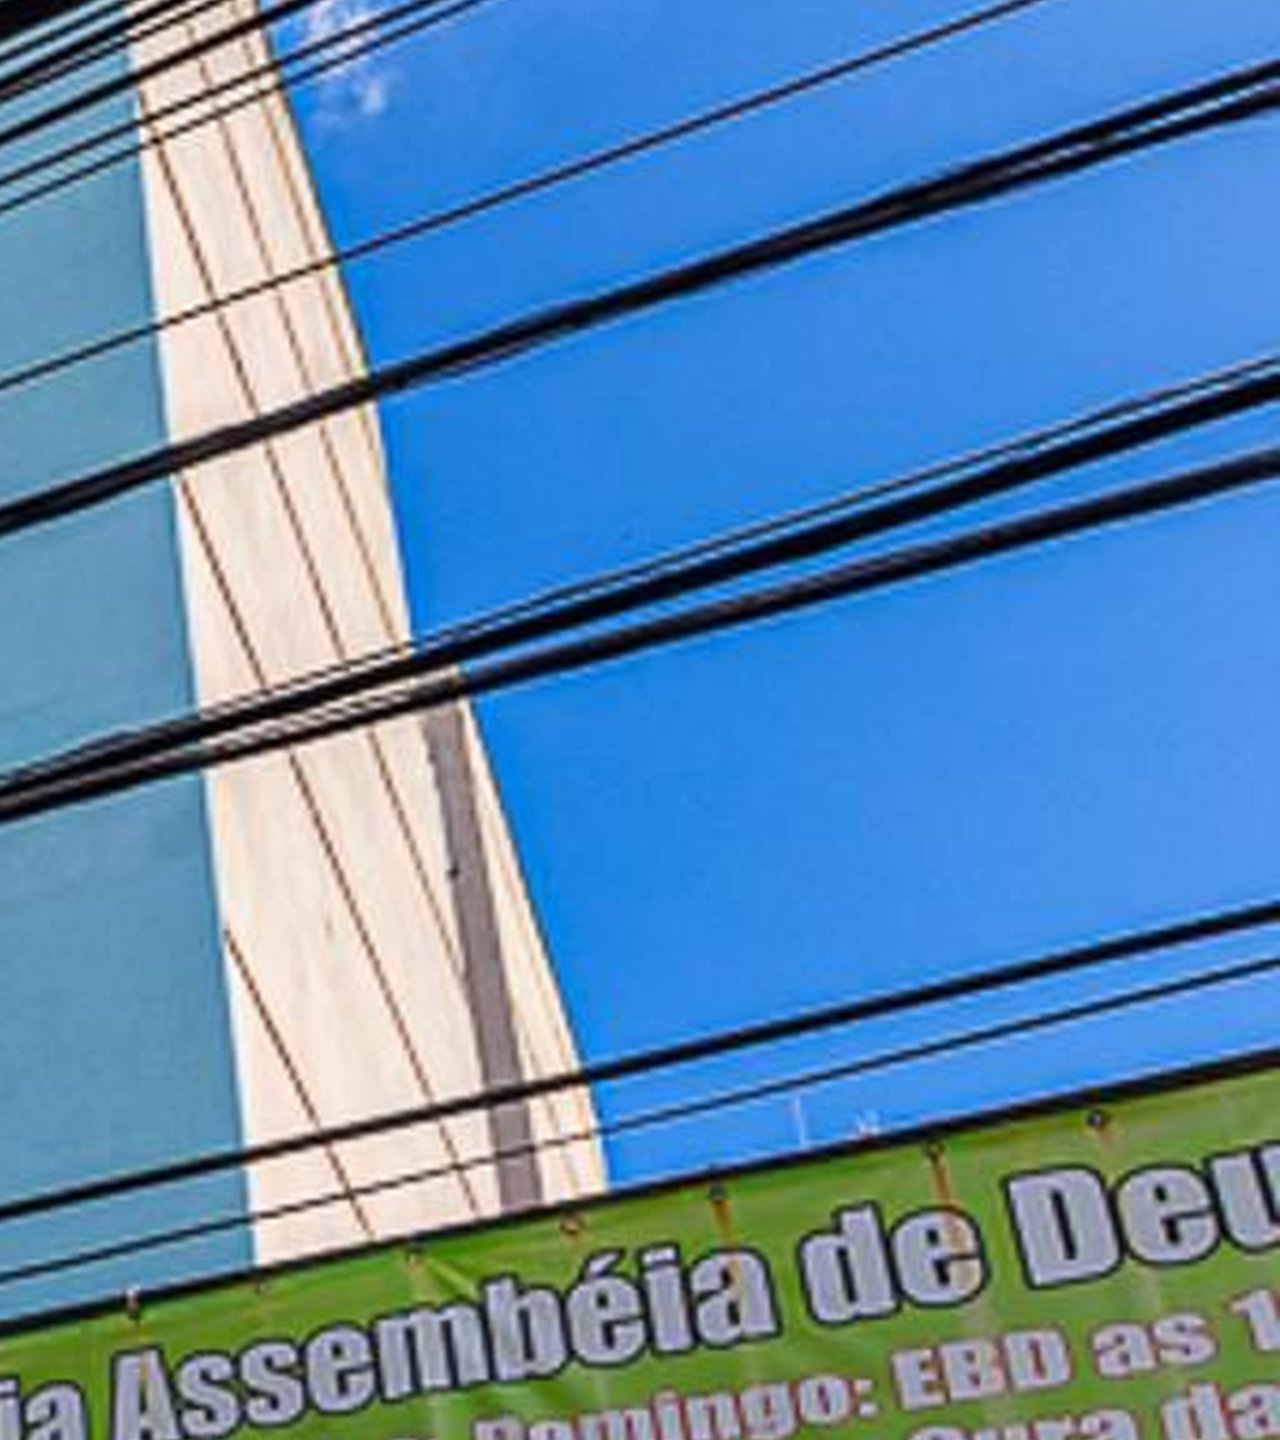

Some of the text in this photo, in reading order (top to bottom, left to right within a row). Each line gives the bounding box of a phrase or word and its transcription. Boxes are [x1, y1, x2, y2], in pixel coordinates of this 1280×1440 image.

[797, 1200, 989, 1327] de
[891, 1327, 1073, 1412] EBD
[1092, 1311, 1217, 1379] as
